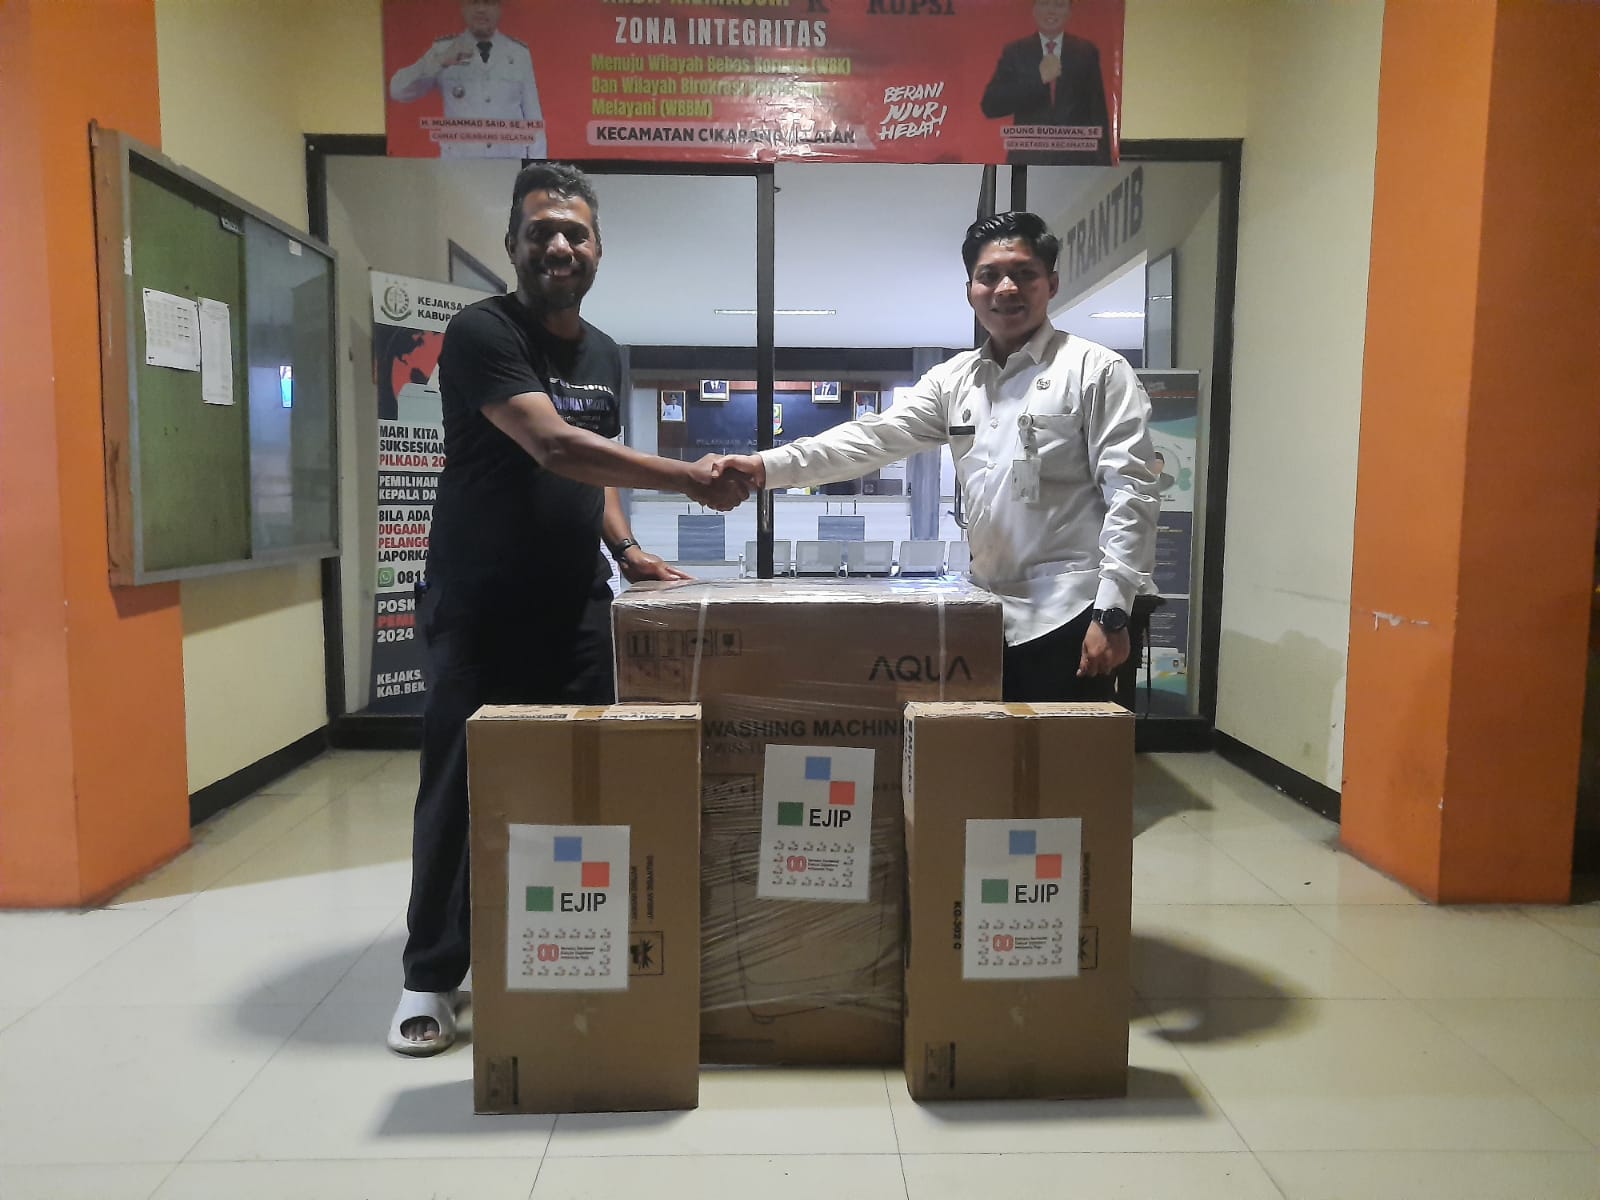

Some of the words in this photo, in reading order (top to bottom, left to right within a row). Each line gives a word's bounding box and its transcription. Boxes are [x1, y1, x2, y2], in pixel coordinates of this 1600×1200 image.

[615, 16, 677, 45] ZONA
[688, 18, 827, 47] INTEGRITAS
[591, 54, 644, 73] Menuju
[647, 54, 704, 74] Wilayah
[707, 55, 751, 74] Bebas
[811, 56, 852, 75] (WBK)
[591, 76, 618, 94] Dan
[621, 76, 677, 96] Wilayah
[883, 81, 945, 105] BERANI
[591, 98, 657, 118] Melayani
[661, 98, 714, 119] (WBBM)
[432, 119, 483, 128] MUHAMMAD
[1003, 127, 1035, 136] UDUNG
[1087, 128, 1099, 136] SE
[596, 126, 695, 142] KECAMATAN
[1066, 164, 1144, 283] TRANTIB
[417, 295, 467, 312] KEJAKSA
[417, 309, 453, 323] KABUP
[379, 425, 409, 439] MARI
[413, 427, 439, 441] KITA
[379, 454, 429, 468] PILKADA
[379, 475, 439, 488] PEMILIHAN
[379, 488, 420, 501] KEPALA
[378, 509, 404, 522] BILA
[407, 509, 431, 522] ADA
[378, 523, 426, 535] DUGAAN
[376, 627, 415, 643] 2024
[867, 655, 973, 682] AQUA
[376, 669, 421, 685] KEJAKS
[703, 720, 806, 737] WASHING
[813, 720, 904, 737] MACHIN
[809, 808, 852, 828] EJIP
[1014, 883, 1059, 904] EJIP
[560, 892, 607, 913] EJIP
